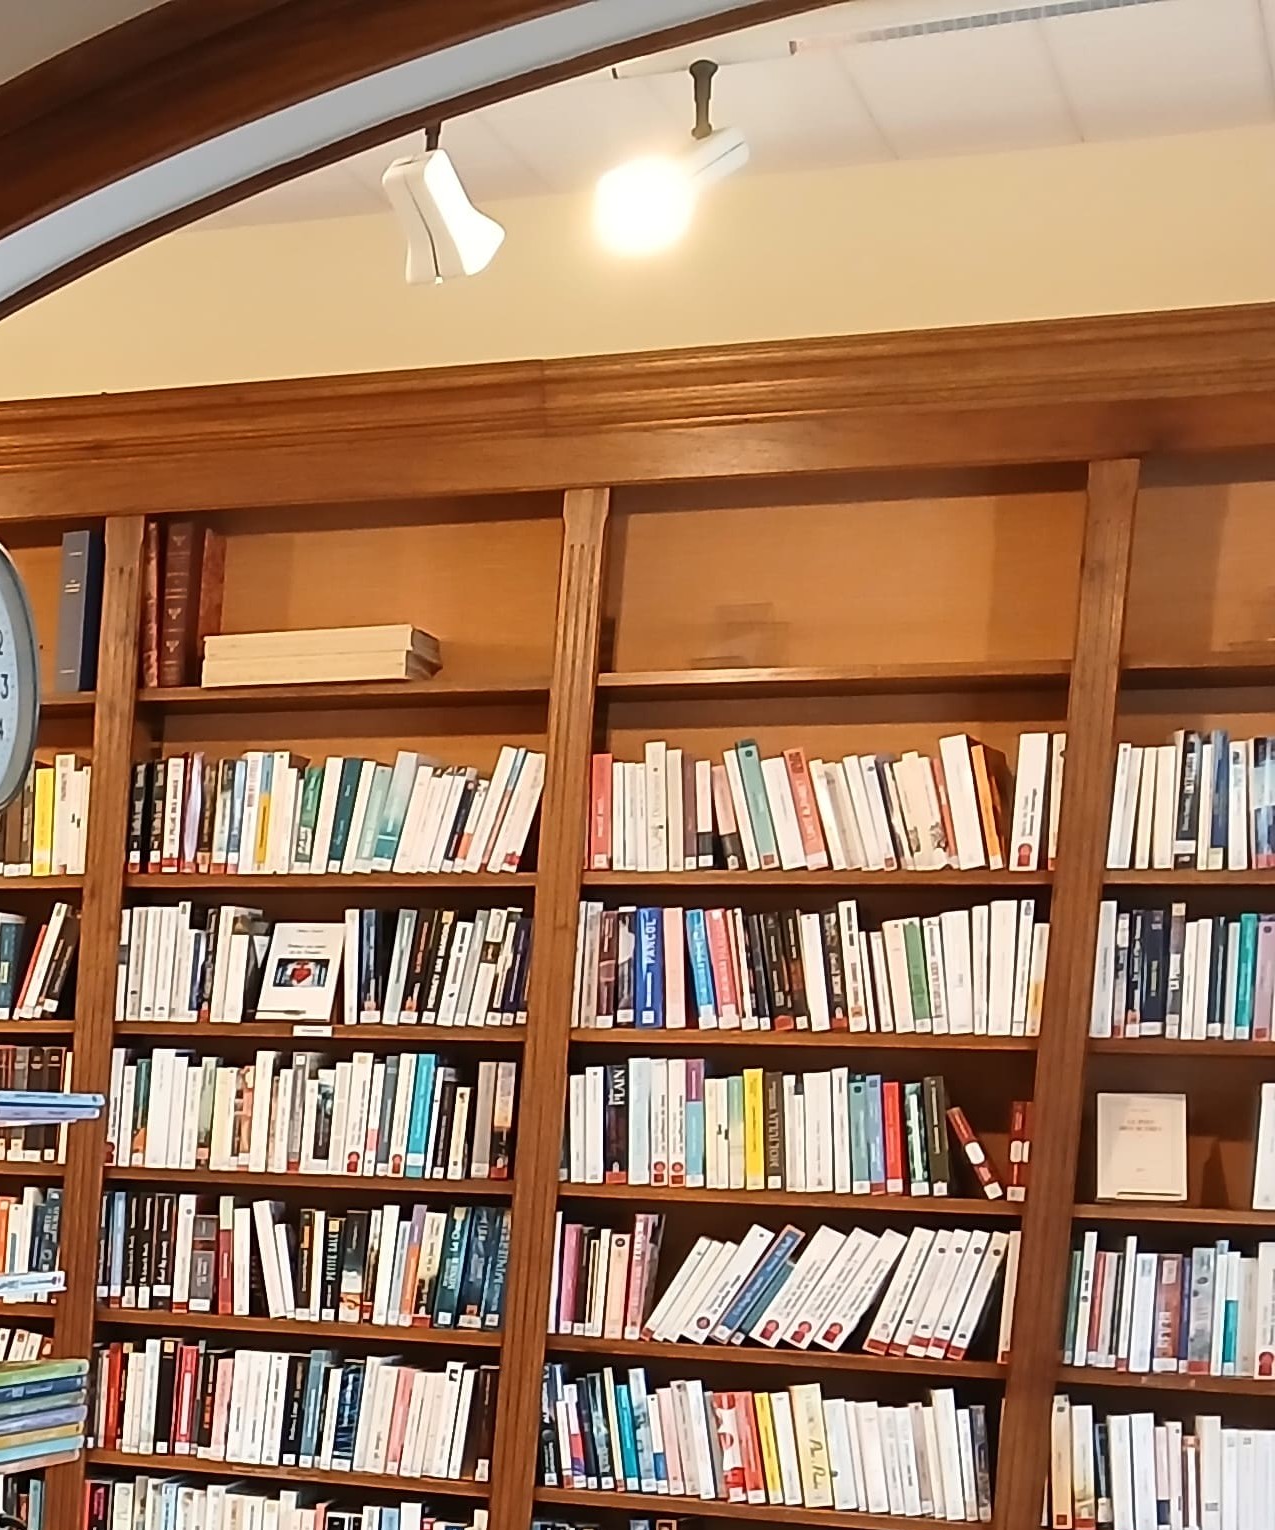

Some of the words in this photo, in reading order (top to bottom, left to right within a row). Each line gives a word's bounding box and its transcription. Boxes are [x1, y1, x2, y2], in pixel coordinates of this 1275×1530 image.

[0, 674, 9, 699] 3
[644, 917, 657, 964] PANCOL
[613, 1069, 625, 1105] PLAIN
[325, 1254, 338, 1281] PETITE
